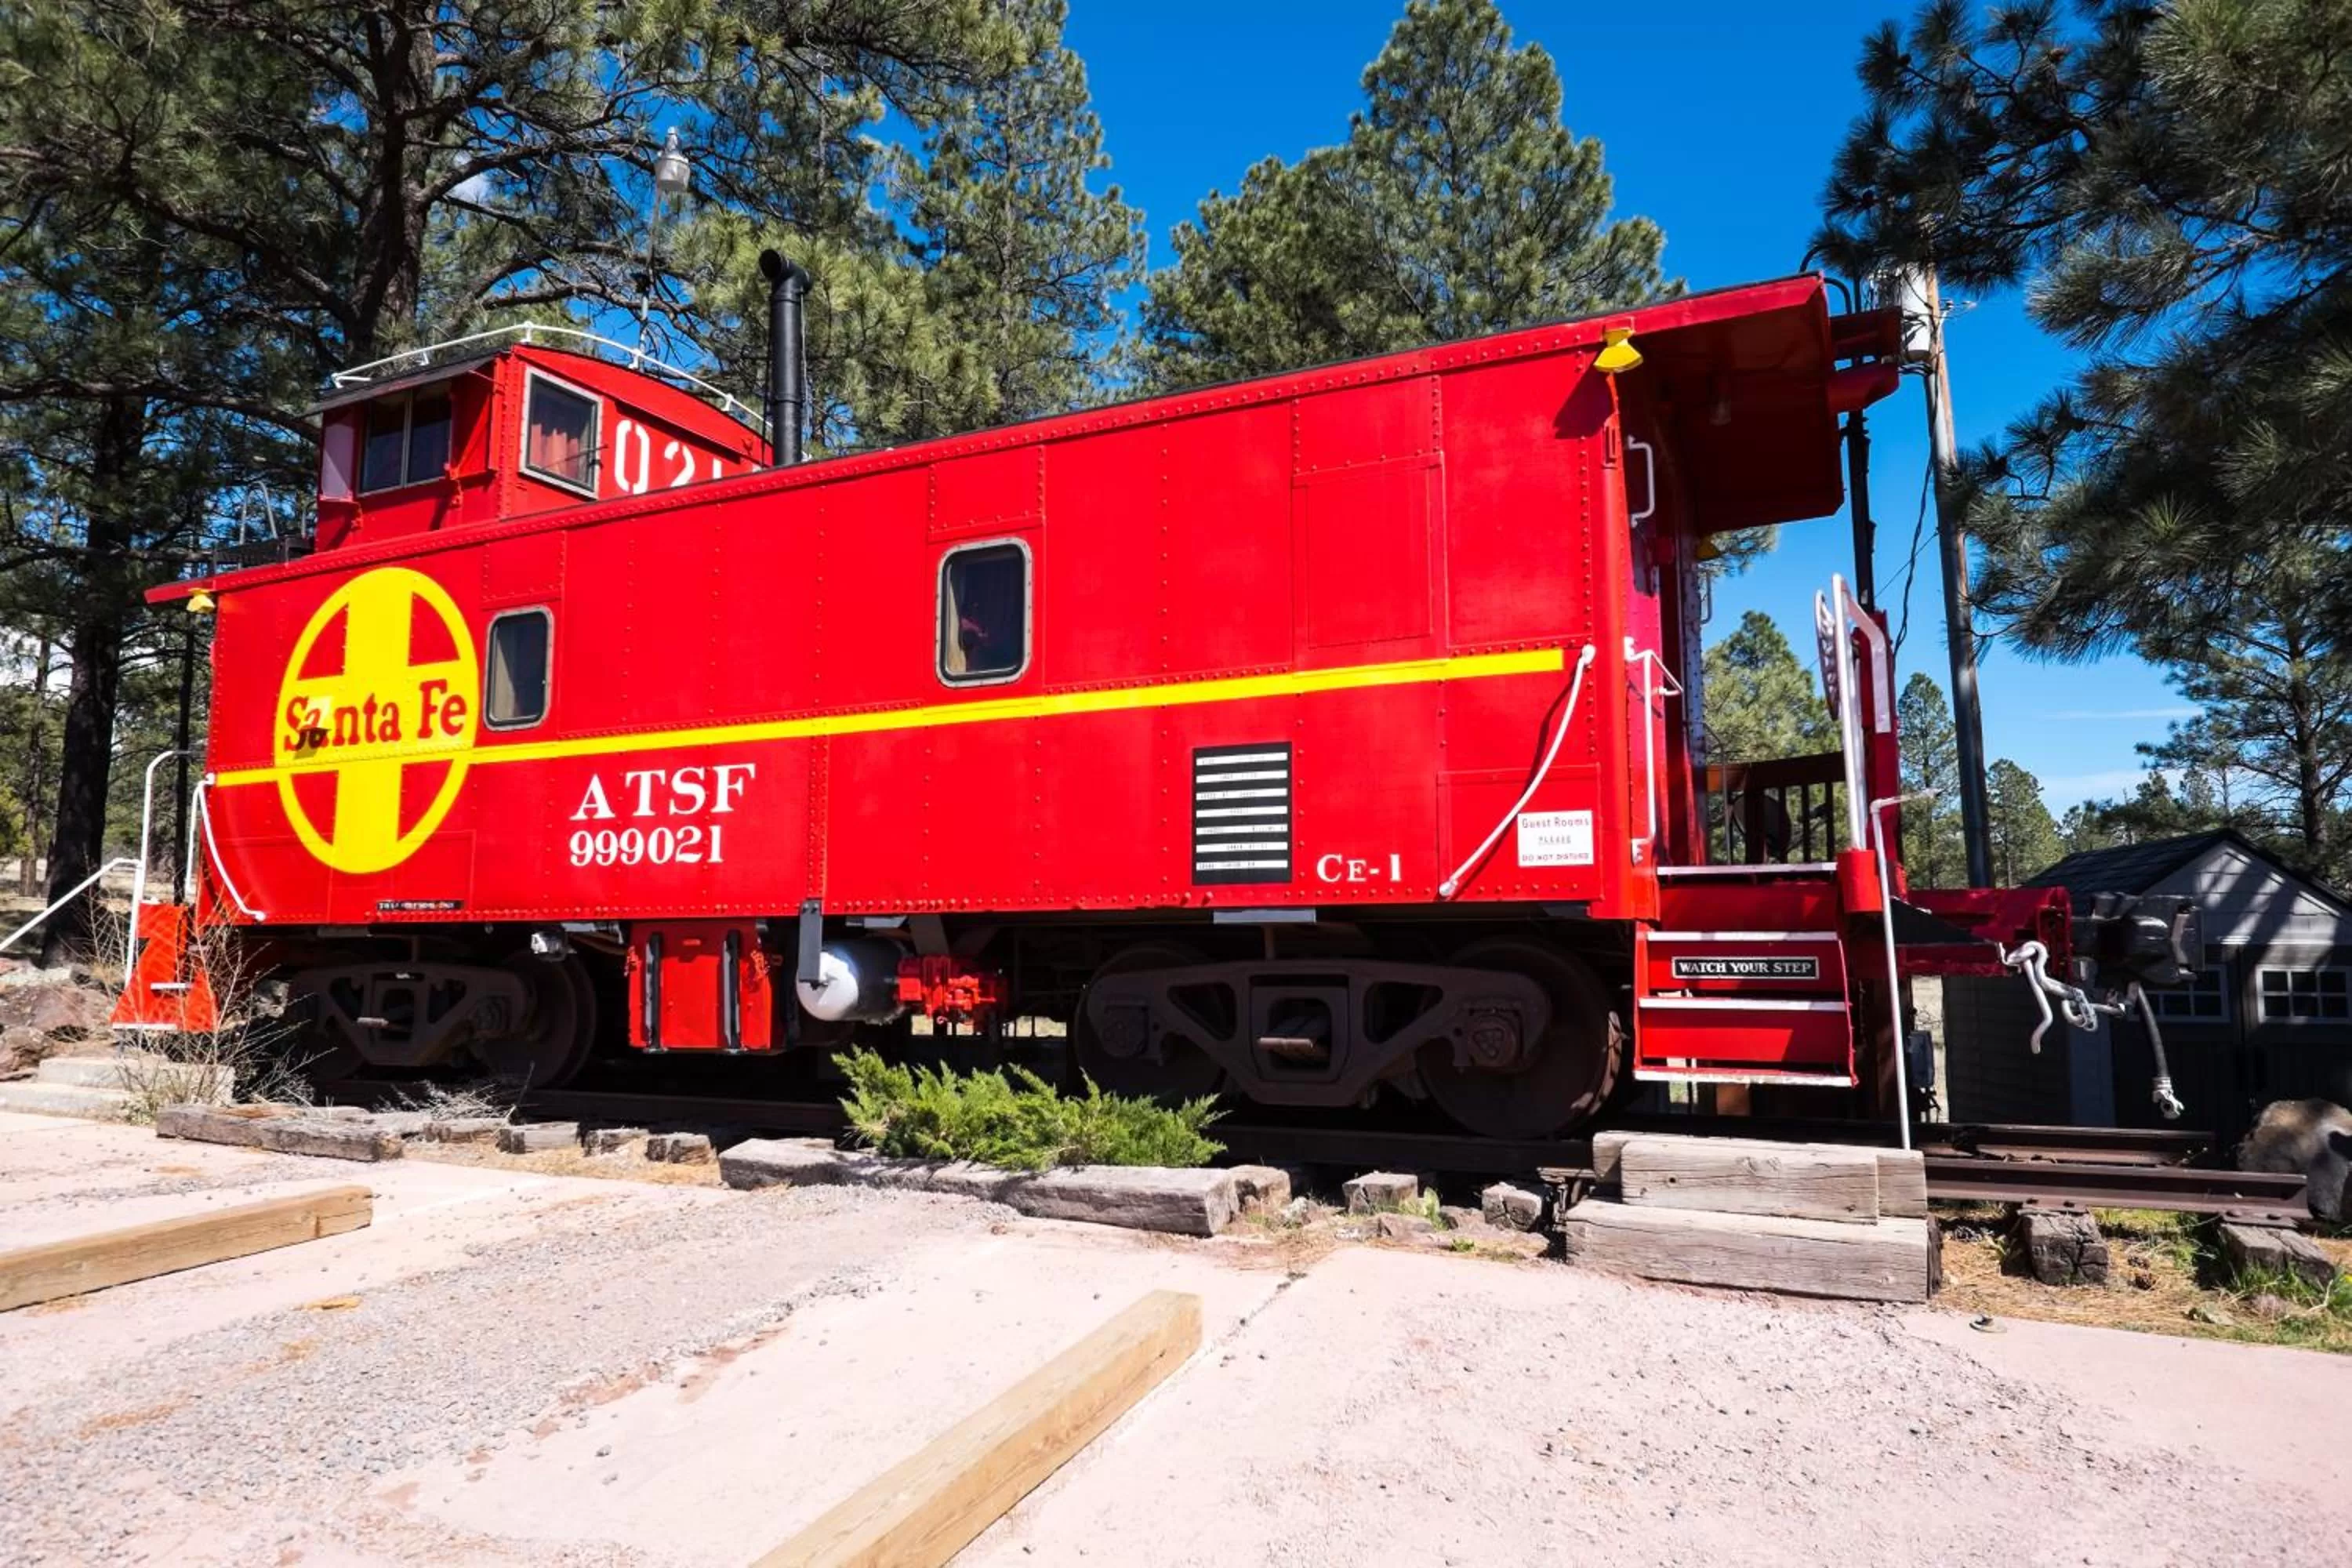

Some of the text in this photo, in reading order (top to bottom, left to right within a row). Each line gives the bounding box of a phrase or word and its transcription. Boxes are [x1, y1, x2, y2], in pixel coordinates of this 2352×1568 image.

[284, 678, 468, 751] Santa Fe
[1522, 816, 1589, 828] Guest Rooms
[569, 824, 724, 866] 999021
[1679, 962, 1812, 973] WATCH YOUR STEP
